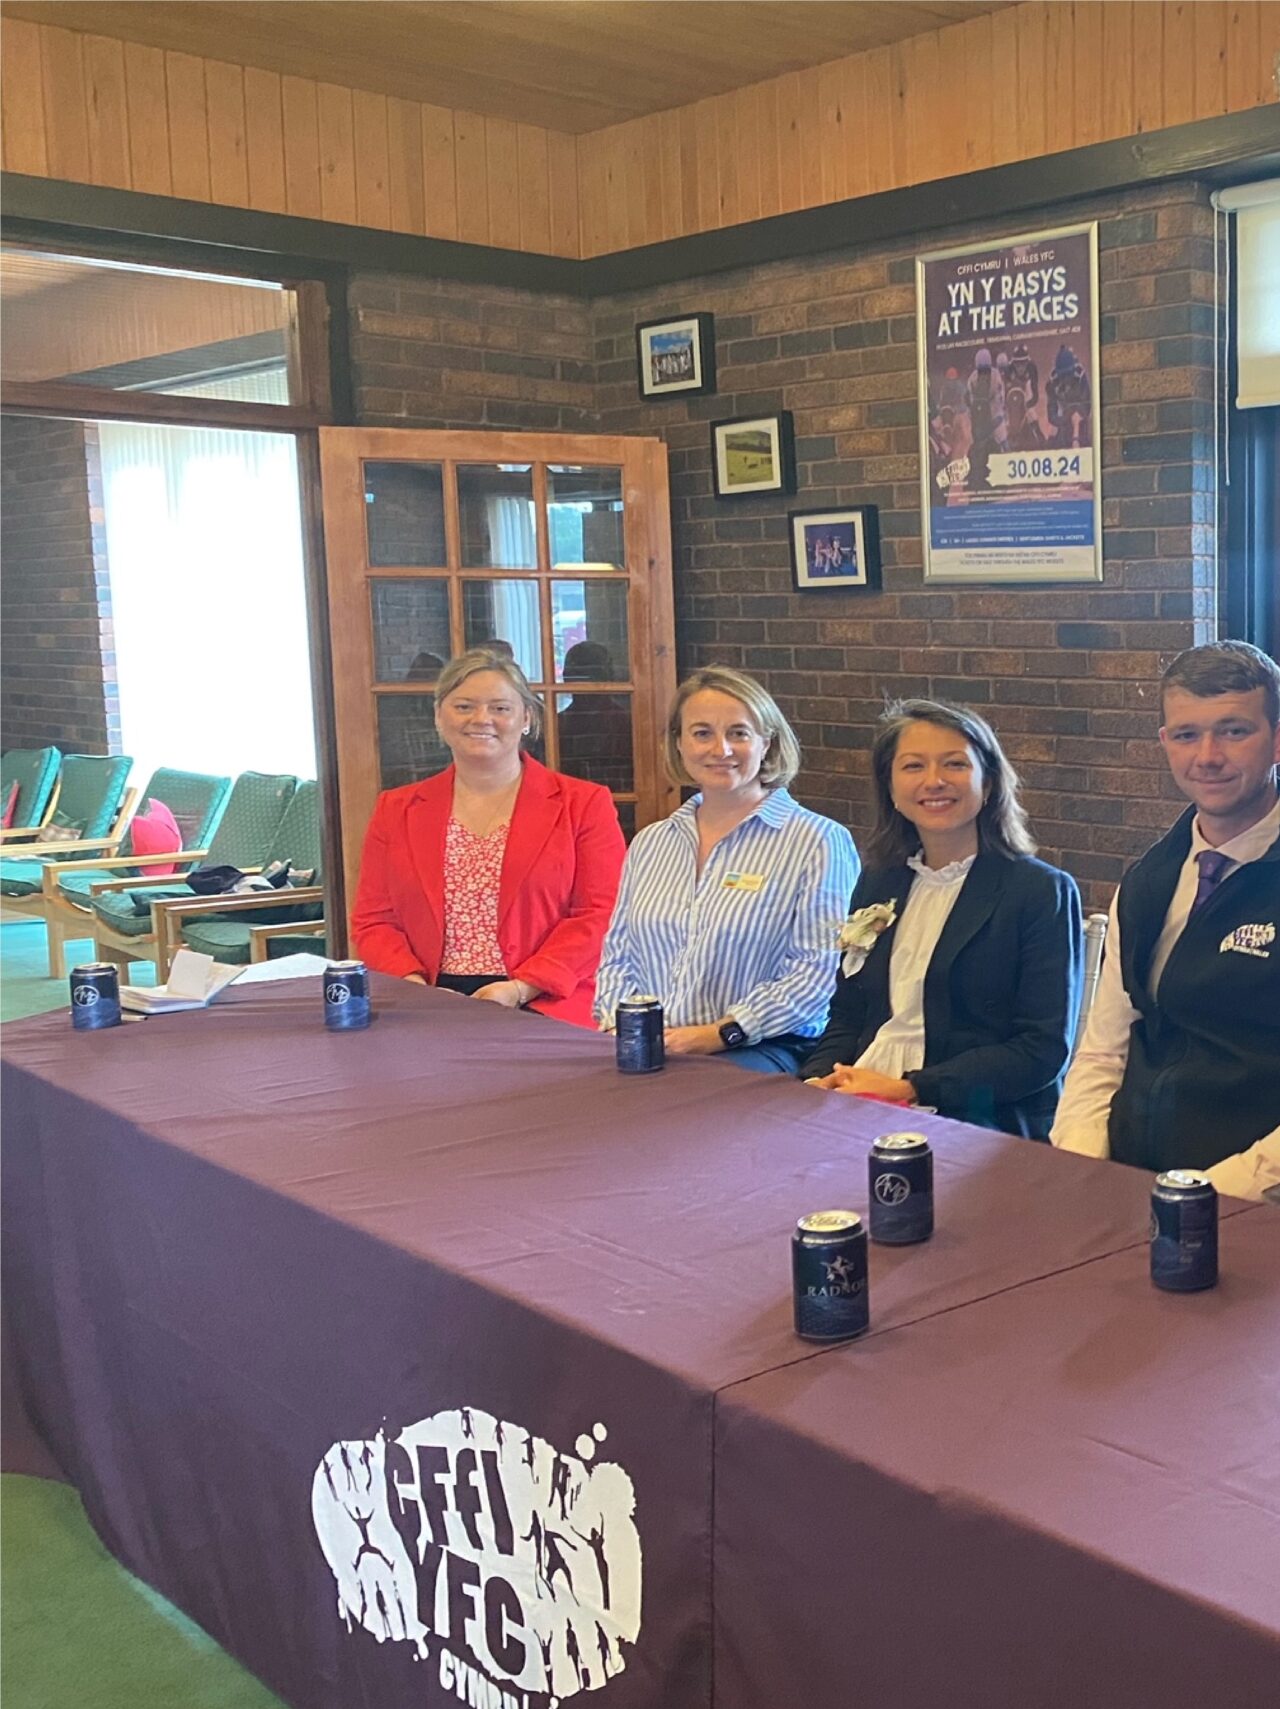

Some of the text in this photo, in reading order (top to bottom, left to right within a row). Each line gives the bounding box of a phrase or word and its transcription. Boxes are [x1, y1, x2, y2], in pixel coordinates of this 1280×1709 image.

[974, 260, 1001, 272] CYMRU
[1013, 253, 1039, 266] WALES
[1040, 250, 1055, 261] YFC
[948, 266, 1066, 307] YN Y RASYS
[938, 293, 1079, 337] AT THE RACES
[1008, 455, 1080, 479] 30.08.24
